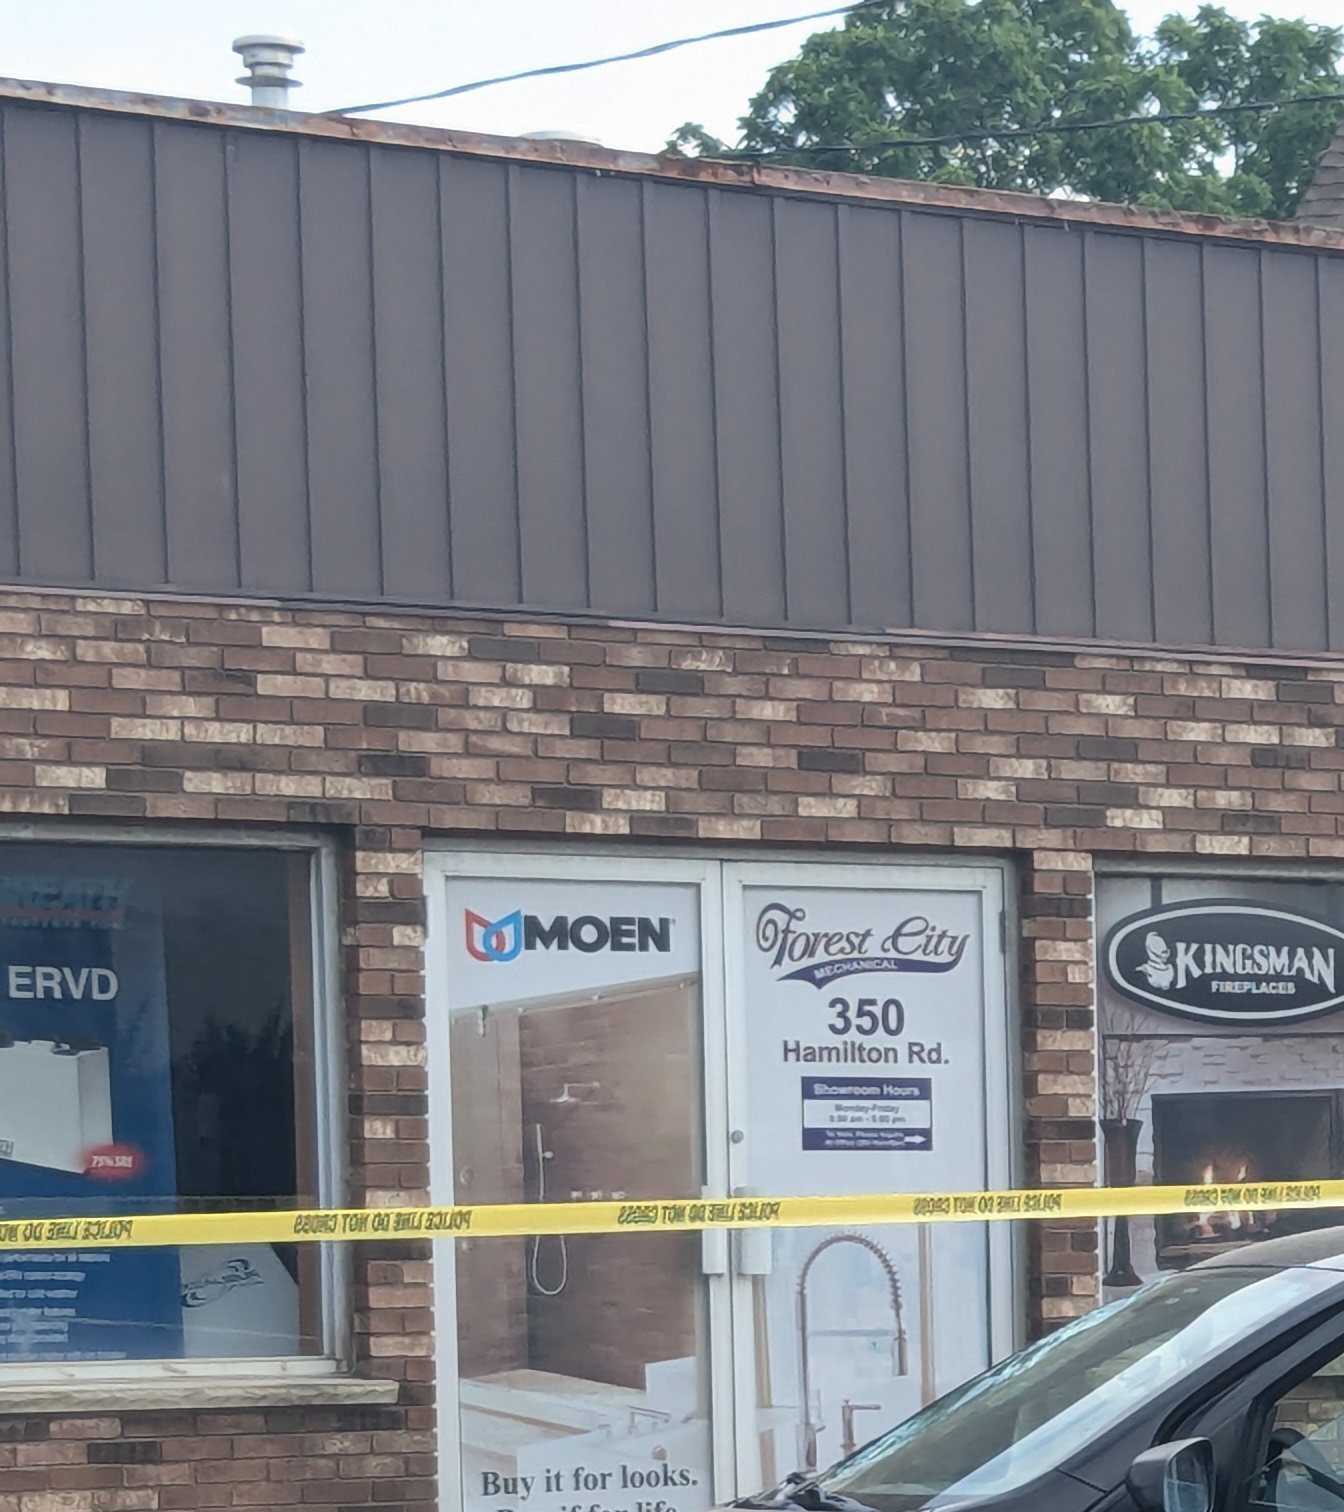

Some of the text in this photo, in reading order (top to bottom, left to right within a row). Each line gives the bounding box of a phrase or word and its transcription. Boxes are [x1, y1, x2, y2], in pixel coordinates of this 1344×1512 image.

[524, 915, 671, 952] MOEN
[756, 902, 970, 970] Forest City
[8, 965, 118, 1001] ERVD
[813, 959, 899, 980] MECHANICAL
[1175, 942, 1336, 993] KINGSMAN
[1211, 981, 1296, 994] FIREPLACES
[828, 997, 905, 1037] 350
[783, 1040, 950, 1065] Hamilton Rd.
[813, 1083, 920, 1097] Showroom Hours
[481, 1463, 698, 1501] Buy it for looks.
